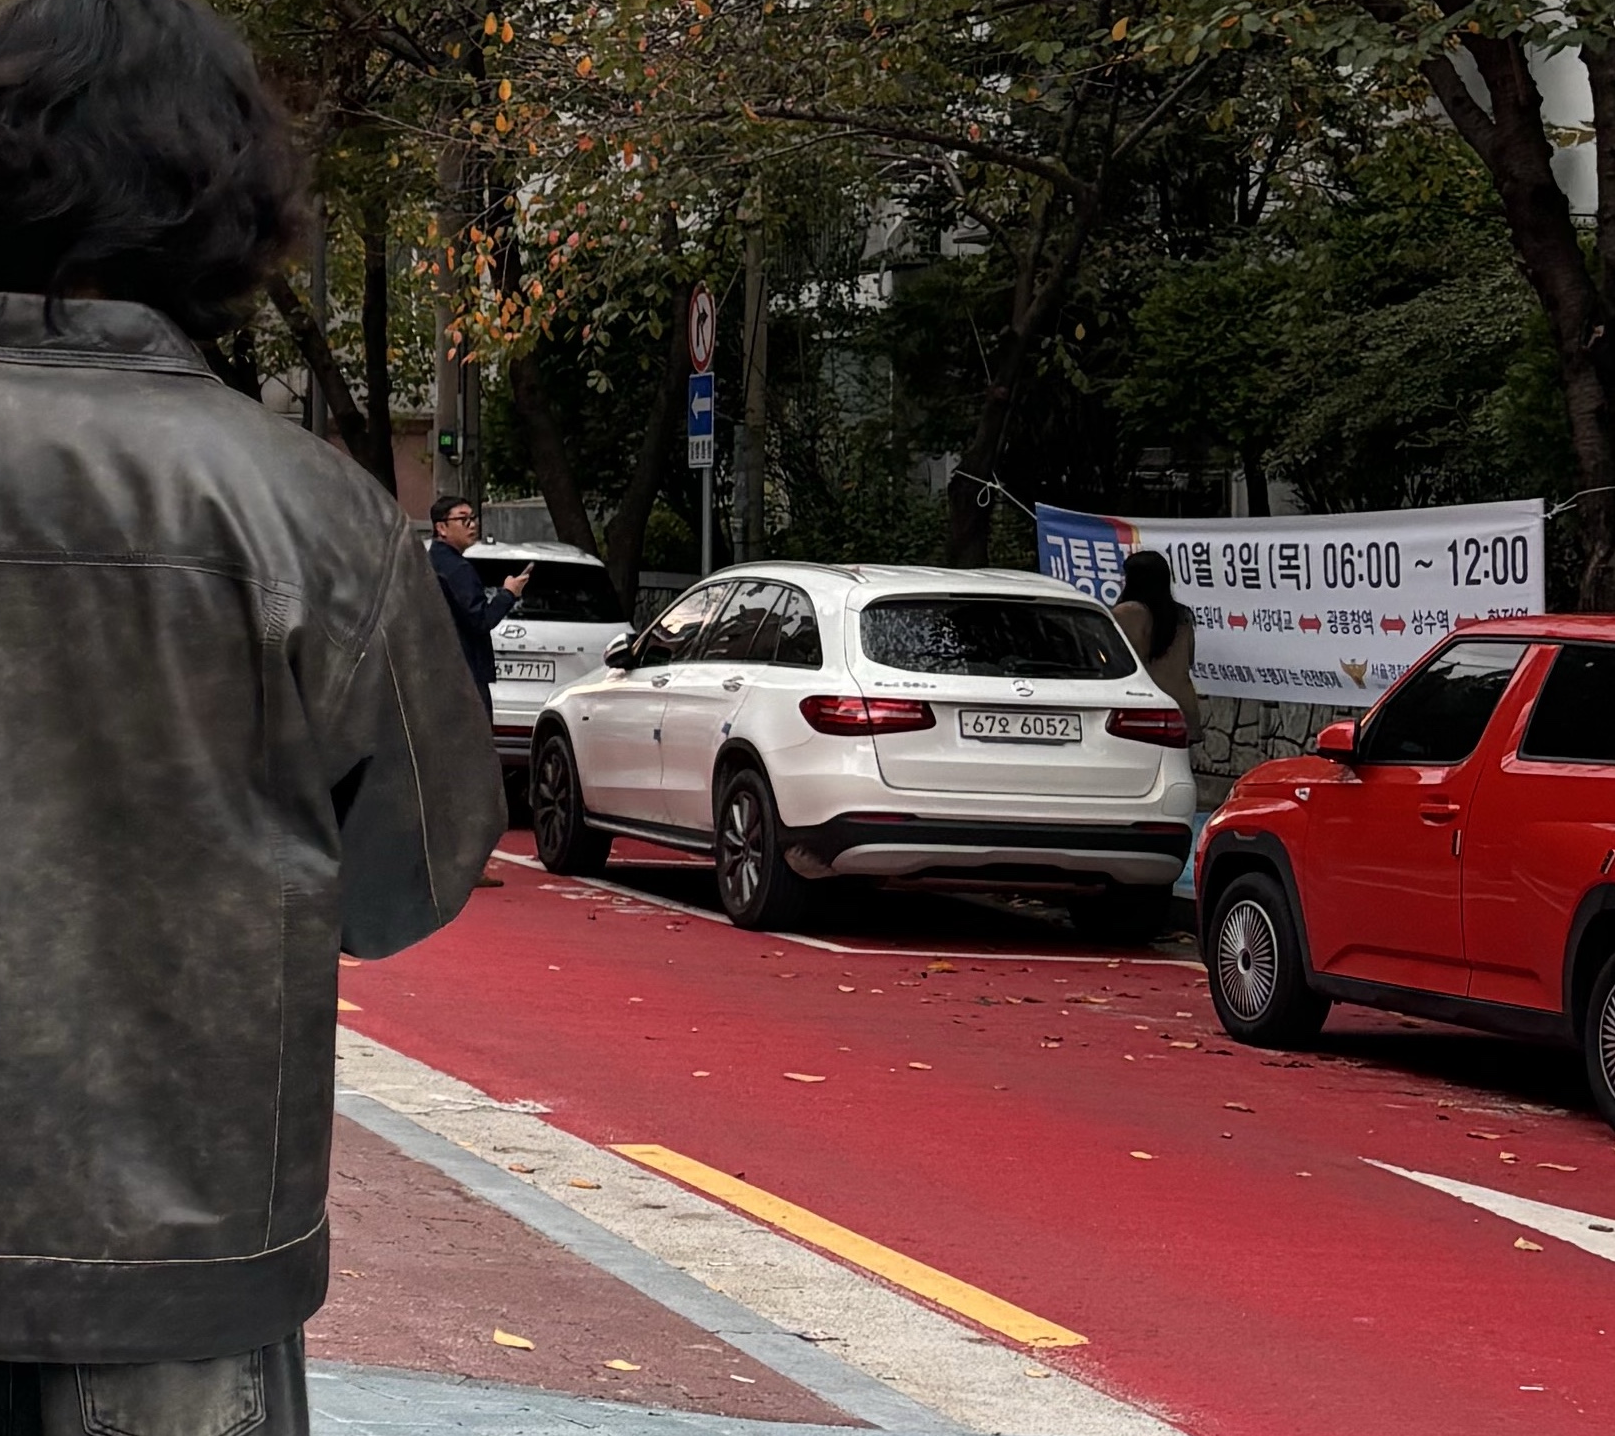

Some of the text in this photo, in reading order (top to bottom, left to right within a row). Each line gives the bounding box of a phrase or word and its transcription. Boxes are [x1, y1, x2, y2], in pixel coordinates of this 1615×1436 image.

[1046, 535, 1141, 606] 교통통
[1165, 541, 1214, 589] 10월
[1223, 542, 1262, 589] 3일
[1269, 542, 1311, 591] (목)
[1323, 541, 1401, 589] 06:00
[1447, 535, 1528, 587] 12:00
[1192, 606, 1450, 635] 도일대 서강대교 광흥창역 상수역
[517, 663, 550, 678] 7717
[1371, 663, 1409, 681] 서울경찰
[973, 715, 1070, 737] 67오 6052
